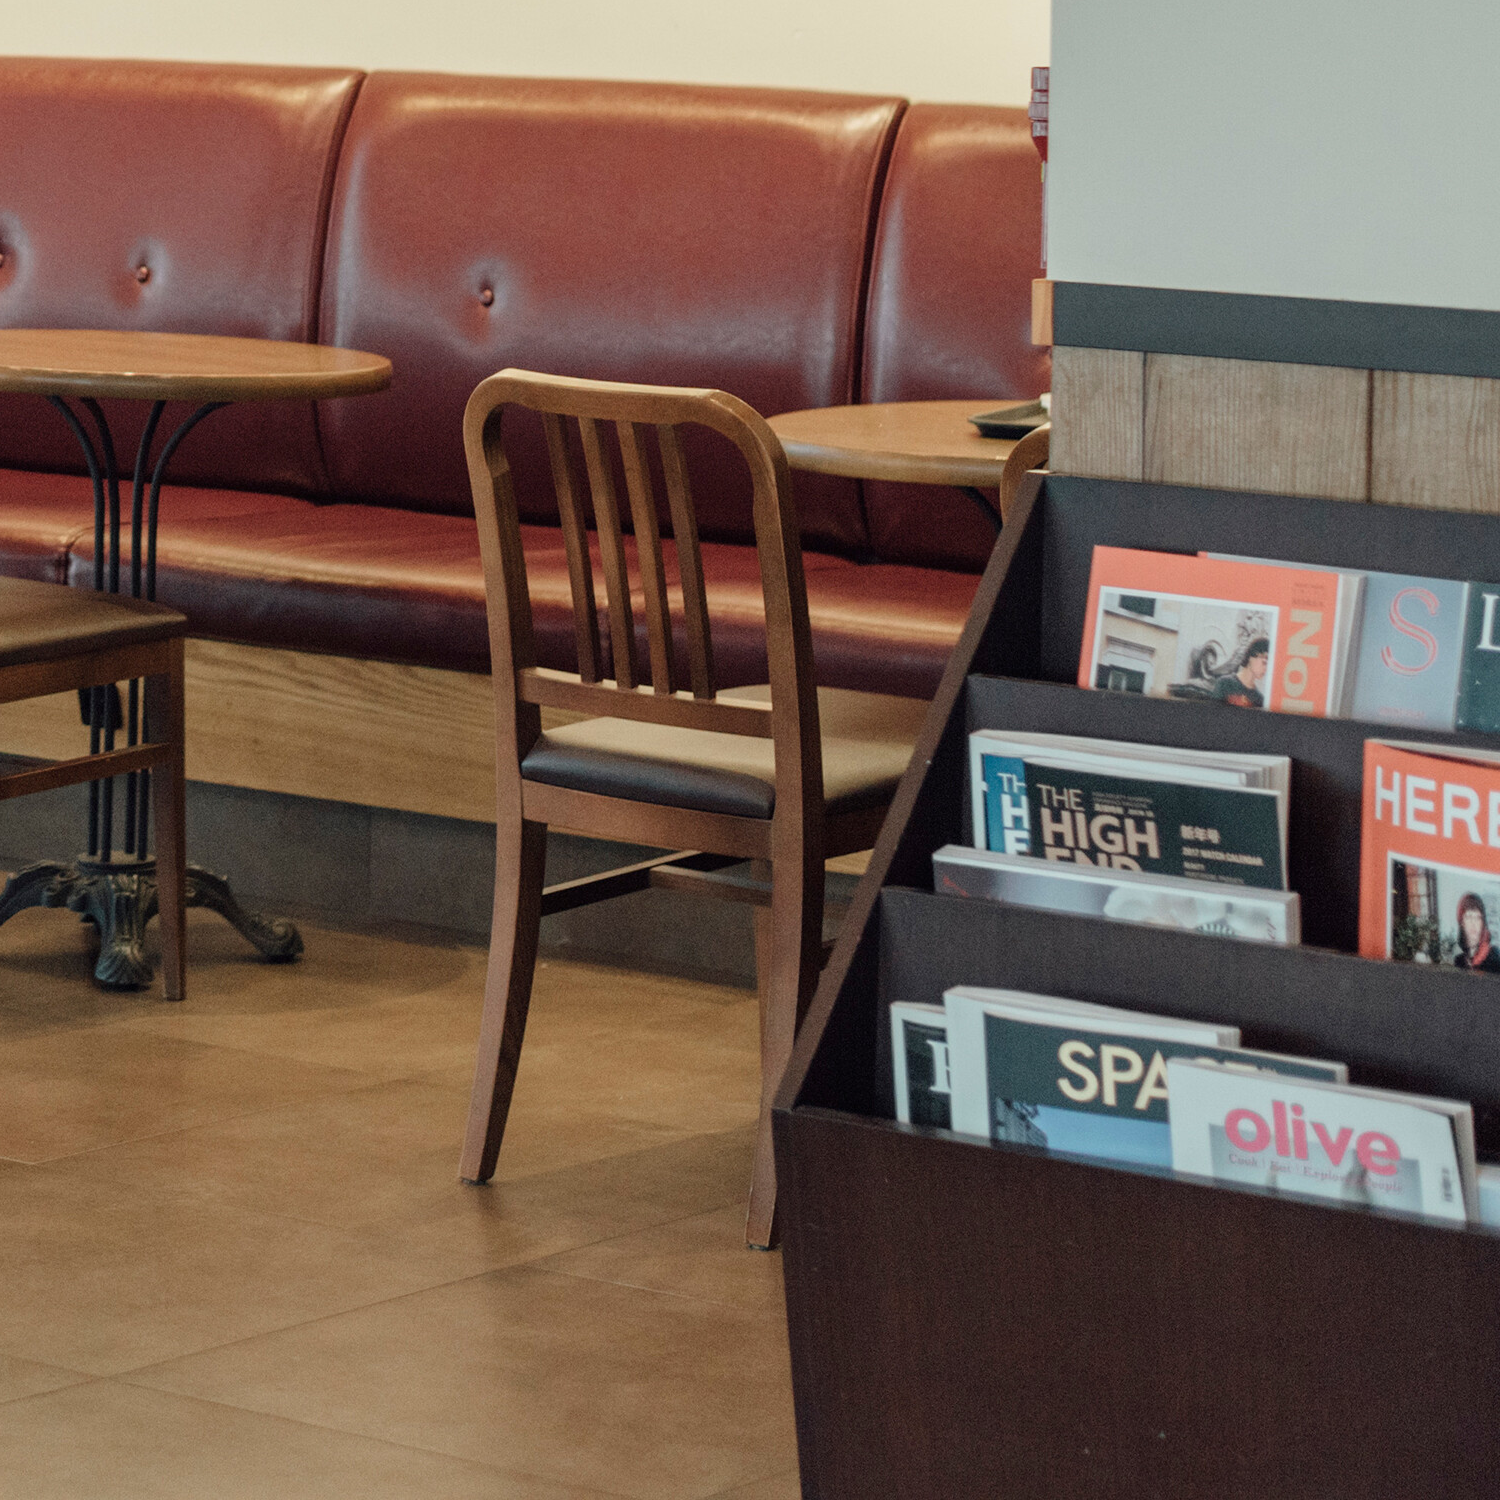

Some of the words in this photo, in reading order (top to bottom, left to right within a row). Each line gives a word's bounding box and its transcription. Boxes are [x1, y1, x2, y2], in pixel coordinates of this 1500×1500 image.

[1036, 783, 1085, 812] THE
[1040, 806, 1162, 860] HIGH
[1224, 1099, 1401, 1176] olive
